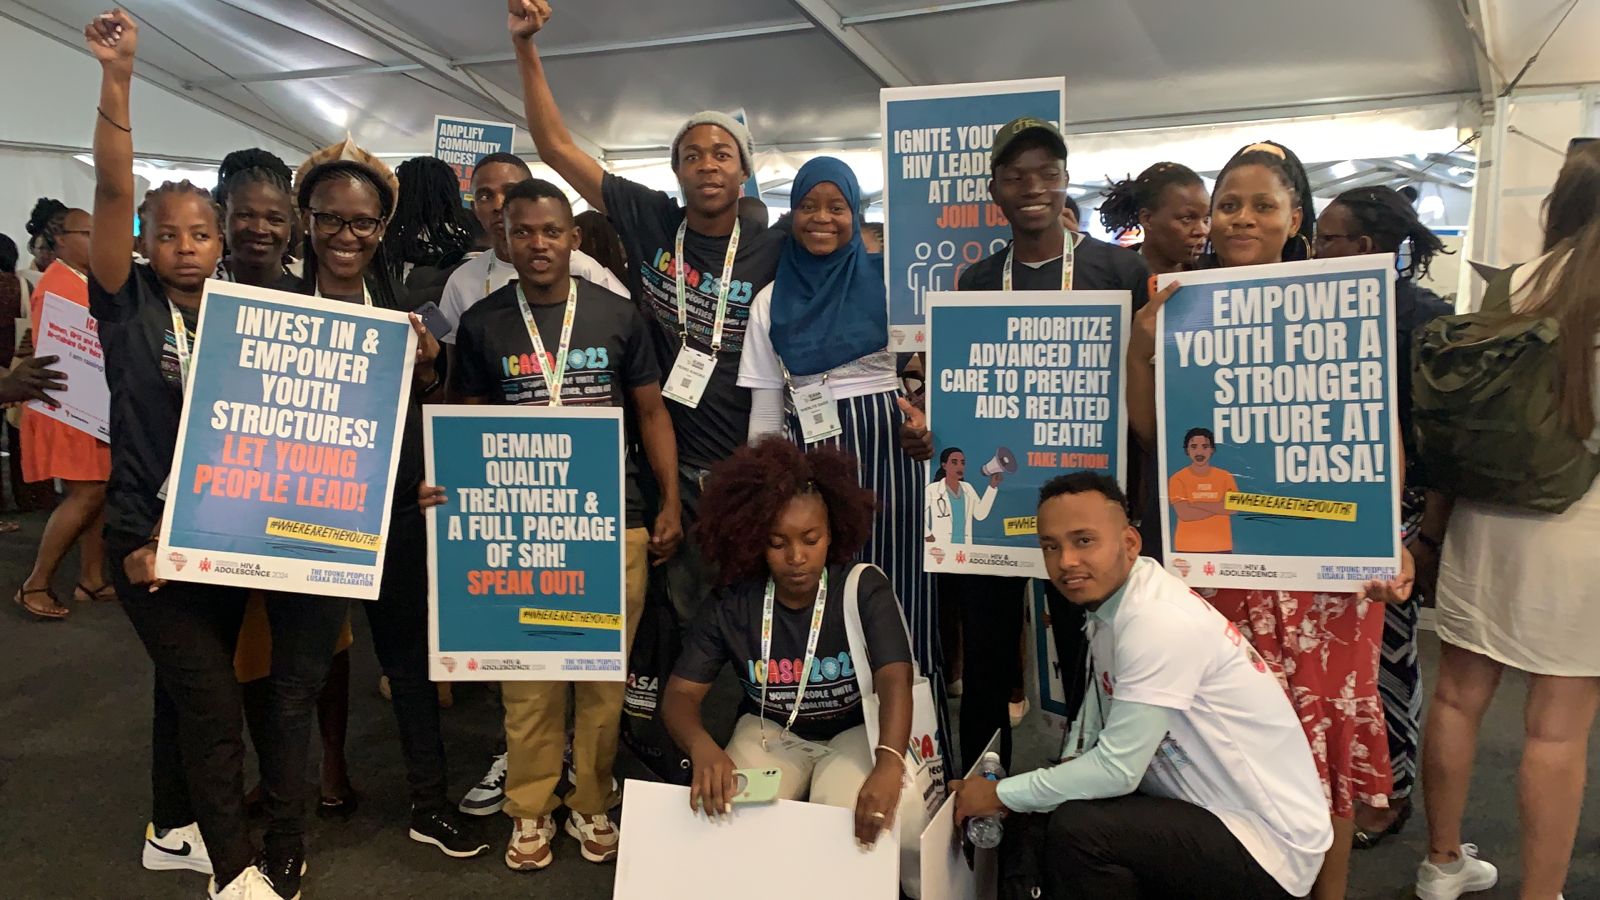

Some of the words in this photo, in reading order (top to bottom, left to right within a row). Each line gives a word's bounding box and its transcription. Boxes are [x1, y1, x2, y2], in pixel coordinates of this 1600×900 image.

[440, 123, 484, 140] AMPLIFY
[894, 127, 952, 154] IGNITE
[957, 124, 1006, 150] YOUT
[437, 150, 476, 166] VOICES!
[438, 136, 501, 154] COMMUNITY
[903, 154, 934, 179] HIV
[939, 152, 993, 177] LEADE
[928, 180, 952, 203] AT
[936, 204, 979, 228] JOIN
[1213, 278, 1380, 326] EMPOWER
[236, 305, 324, 345] INVEST
[329, 320, 356, 350] IN
[362, 328, 380, 354] &
[1007, 316, 1112, 341] PRIORITIZE
[969, 343, 1072, 367] ADVANCED
[1077, 344, 1112, 368] HIV
[1175, 326, 1273, 367] YOUTH
[1285, 321, 1347, 362] FOR
[1358, 319, 1382, 359] A
[239, 338, 369, 384] EMPOWER
[261, 374, 341, 412] YOUTH
[940, 369, 989, 393] CARE
[994, 369, 1018, 393] TO
[1024, 370, 1111, 395] PREVENT
[1214, 361, 1383, 404] STRONGER
[975, 395, 1020, 419] AIDS
[1025, 396, 1110, 420] RELATED
[211, 400, 378, 448] STRUCTURES!
[1034, 422, 1103, 447] DEATH!
[1213, 404, 1332, 443] FUTURE
[1342, 403, 1384, 441] AT
[222, 434, 268, 468] LET
[275, 440, 357, 479] YOUNG
[482, 433, 572, 458] DEMAND
[1027, 452, 1058, 467] TAKE
[1061, 453, 1109, 469] ACTION!
[1275, 444, 1385, 483] ICASA!
[485, 461, 570, 487] QUALITY
[193, 464, 290, 504] PEOPLE
[296, 475, 368, 512] LEAD!
[457, 488, 578, 513] TREATMENT
[584, 491, 599, 514] &
[448, 515, 463, 540] A
[468, 516, 518, 541] FULL
[523, 516, 616, 542] PACKAGE
[1007, 517, 1036, 529] #WHE
[486, 543, 512, 568] OF
[518, 543, 566, 568] SRH!
[214, 567, 270, 577] ADOLESCENCE
[467, 570, 534, 595] SPEAK
[539, 570, 585, 596] OUT!
[809, 651, 855, 683] 202
[627, 673, 658, 691] ASA
[803, 690, 829, 699] EOPLE
